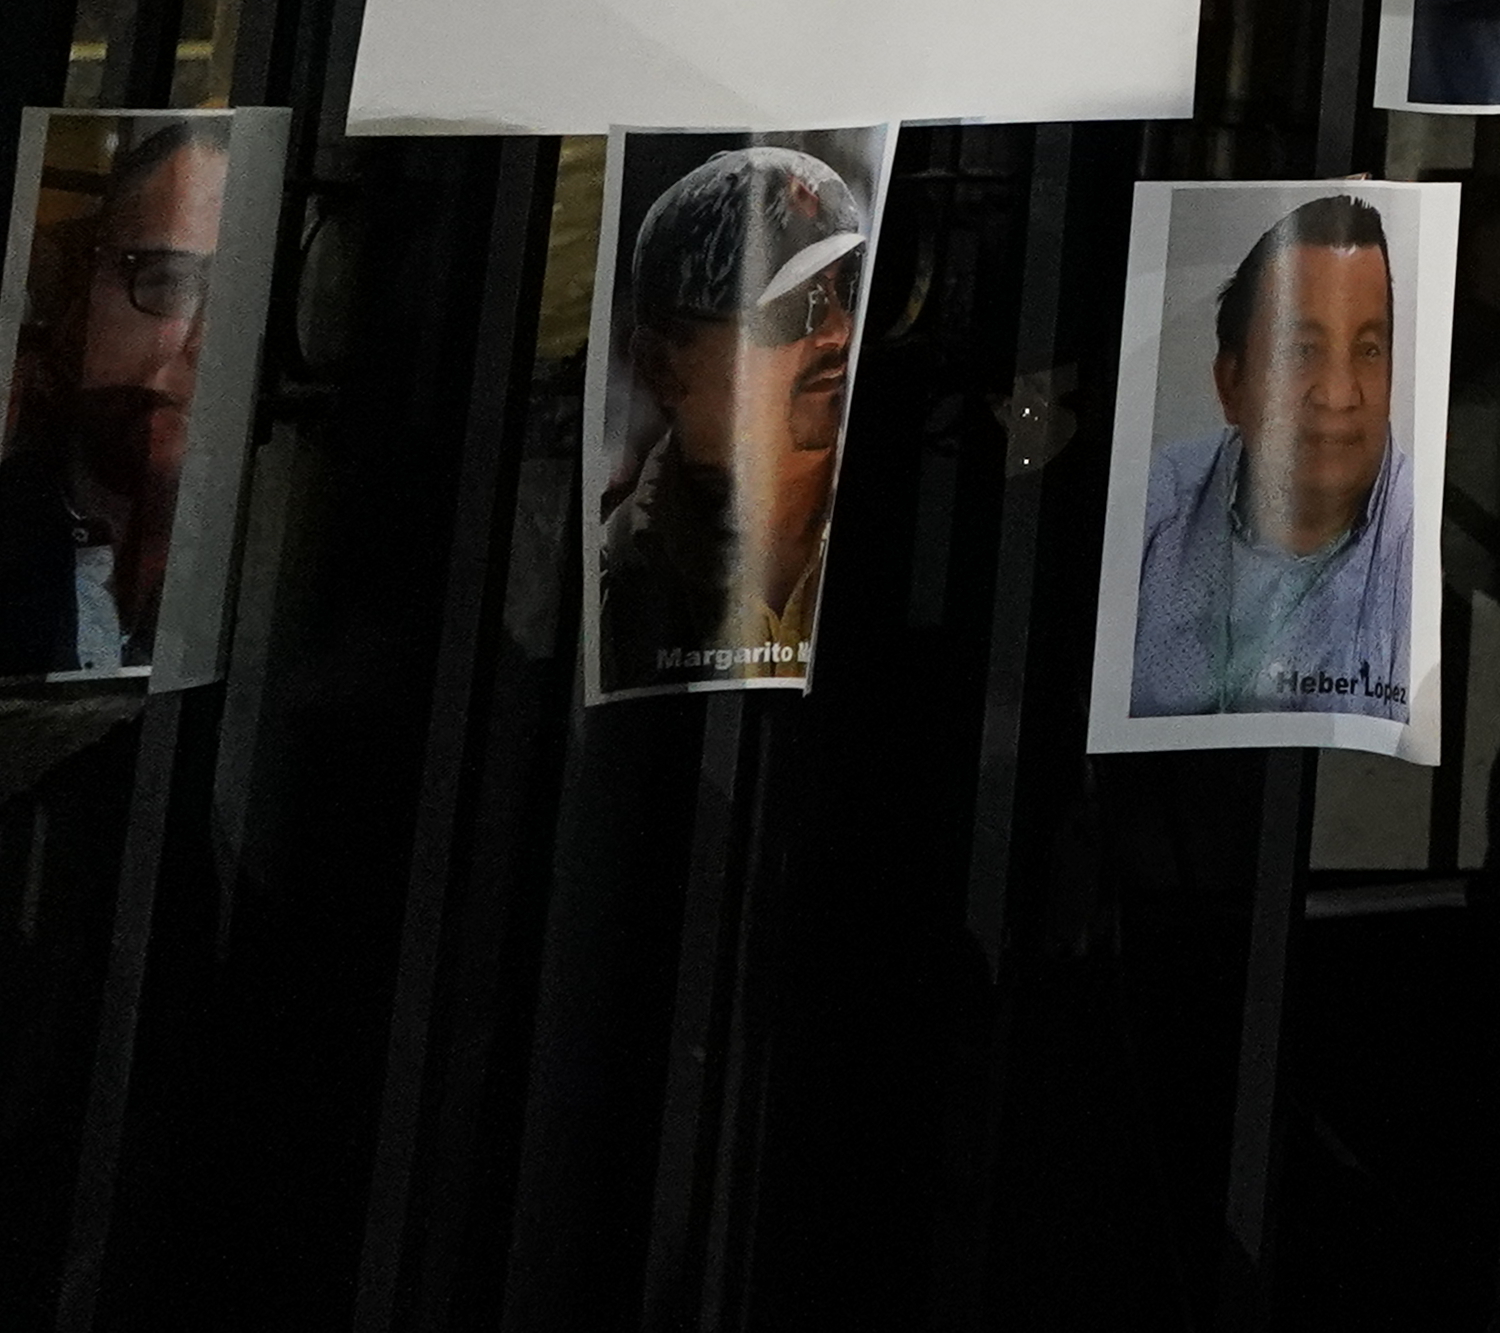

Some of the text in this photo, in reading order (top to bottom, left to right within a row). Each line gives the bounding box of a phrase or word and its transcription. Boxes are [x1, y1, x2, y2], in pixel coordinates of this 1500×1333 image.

[656, 641, 794, 671] Margarito
[1277, 670, 1407, 705] Heber López
